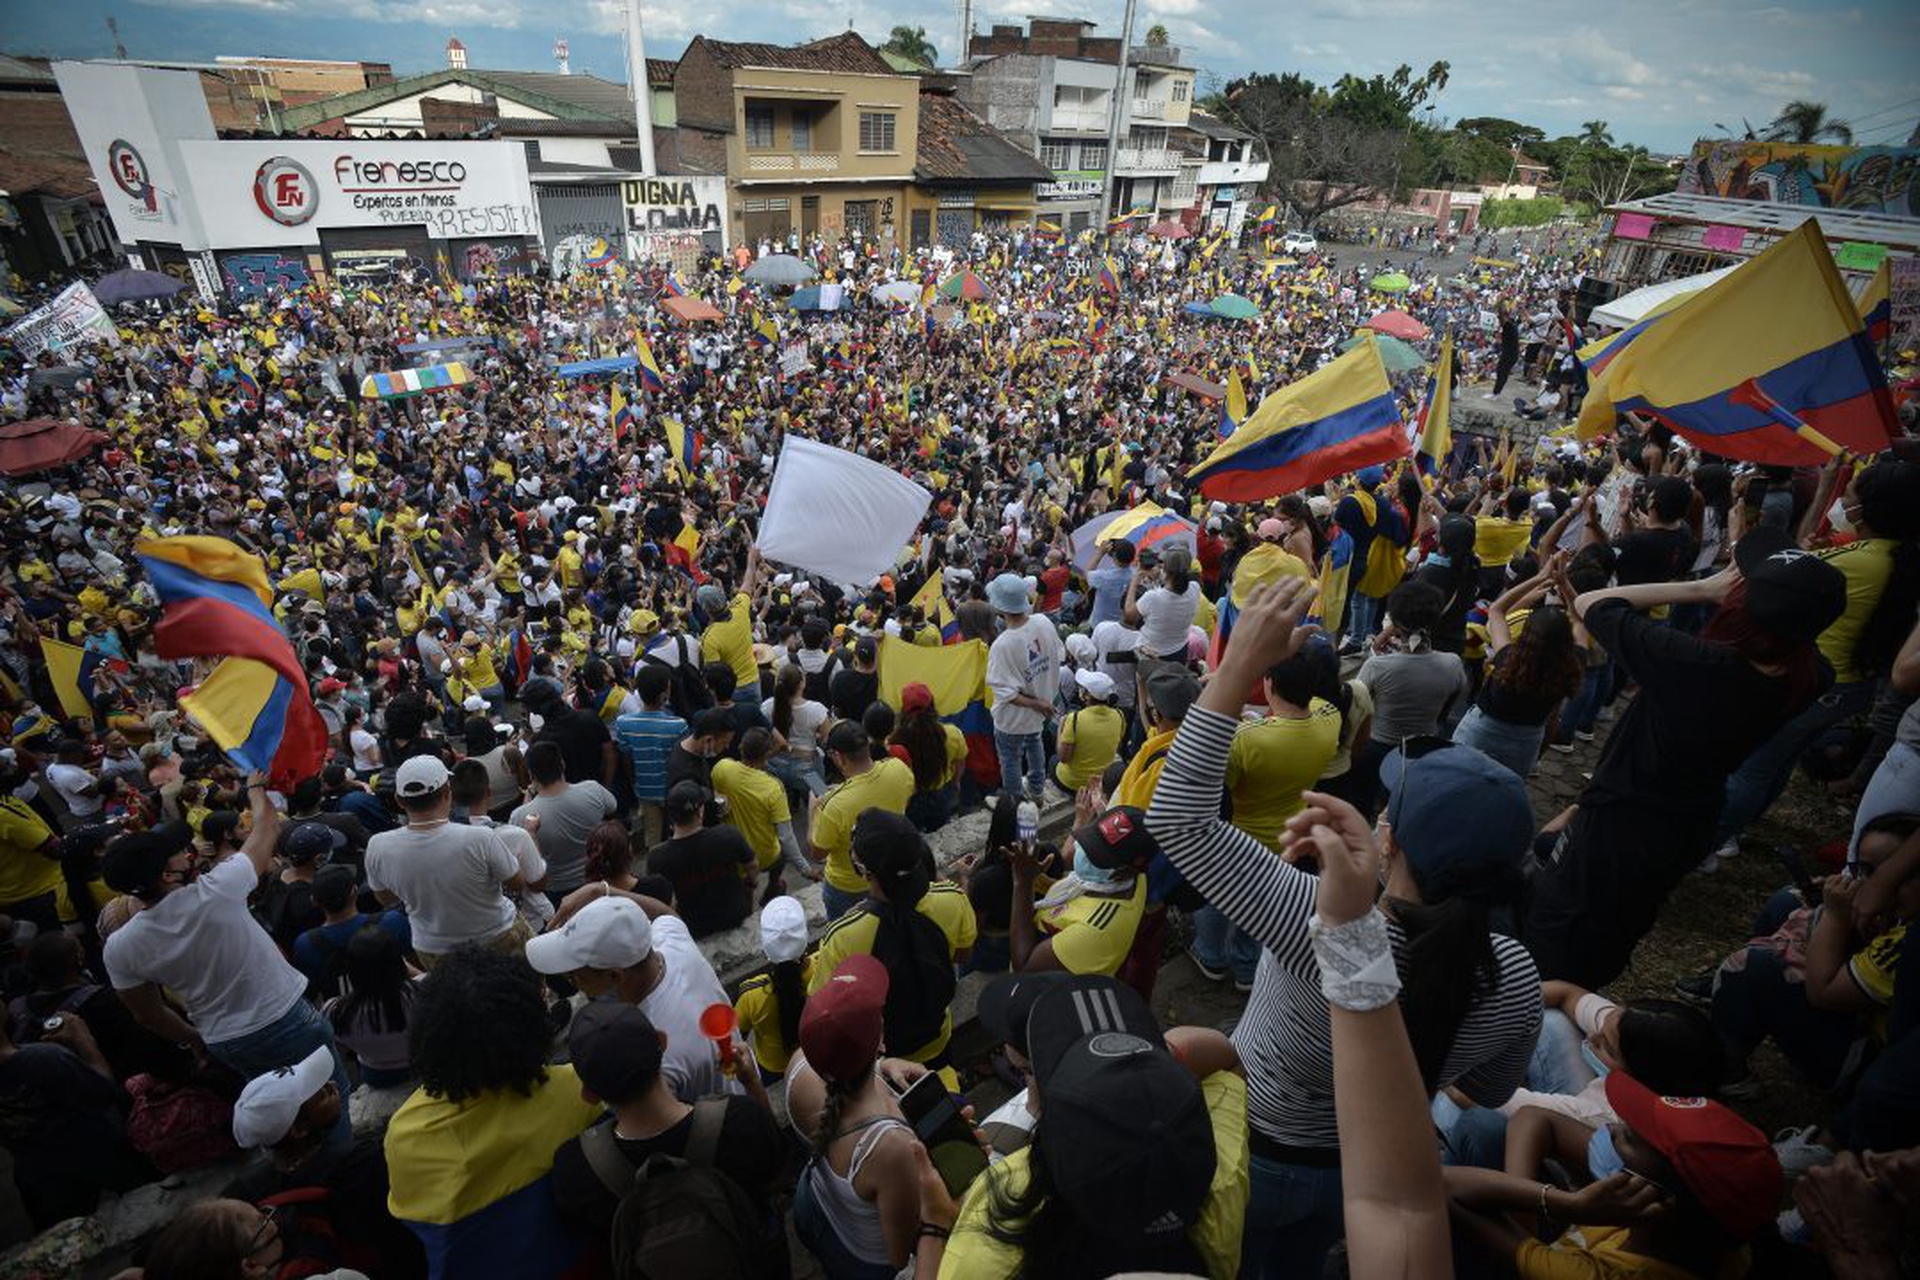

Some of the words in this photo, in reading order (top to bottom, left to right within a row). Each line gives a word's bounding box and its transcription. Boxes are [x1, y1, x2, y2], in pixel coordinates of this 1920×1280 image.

[334, 155, 467, 184] Frenesco
[353, 194, 403, 211] Expertos
[405, 197, 420, 207] en
[625, 181, 698, 206] DIGNA
